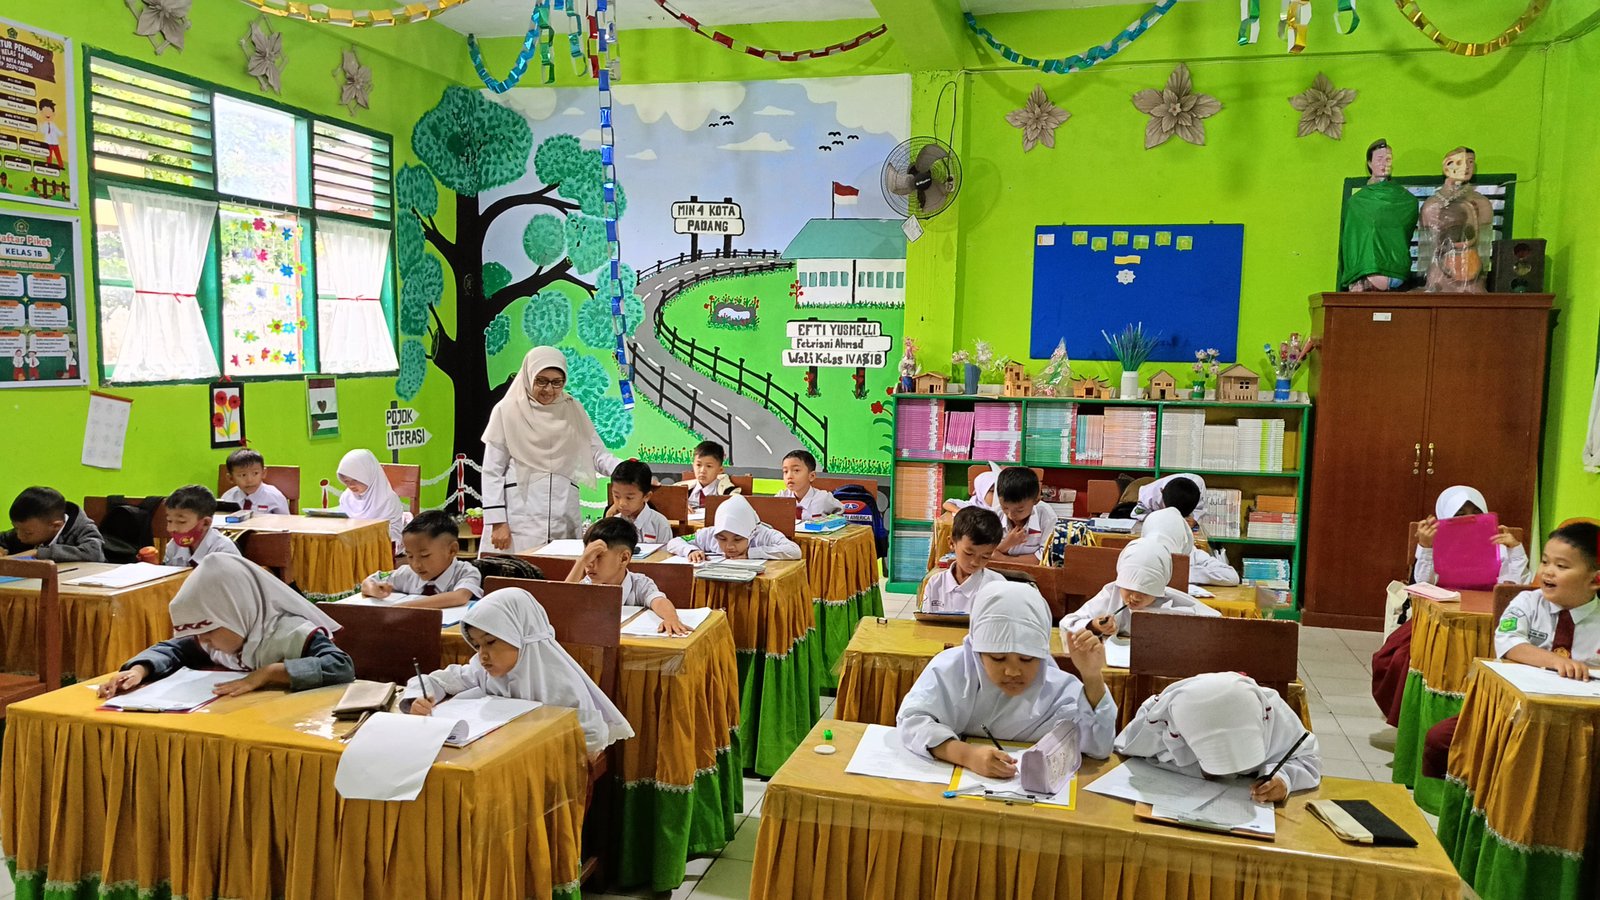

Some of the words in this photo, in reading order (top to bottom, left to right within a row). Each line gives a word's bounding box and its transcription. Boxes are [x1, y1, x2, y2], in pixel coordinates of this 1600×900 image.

[14, 43, 44, 62] PENGURUS
[678, 205, 695, 216] MIN
[697, 205, 704, 216] 4
[709, 205, 736, 216] KOTA
[687, 220, 729, 232] PADANG
[26, 235, 52, 247] Piket
[5, 247, 32, 257] KELAS
[798, 324, 826, 336] EFTI
[830, 324, 876, 336] YUSMELLI
[796, 339, 833, 349] Fetriani
[834, 339, 864, 349] Ahmad
[788, 351, 814, 364] Wali
[815, 353, 843, 365] Kelas
[386, 409, 413, 424] POJOK
[387, 428, 425, 446] LITERASI
